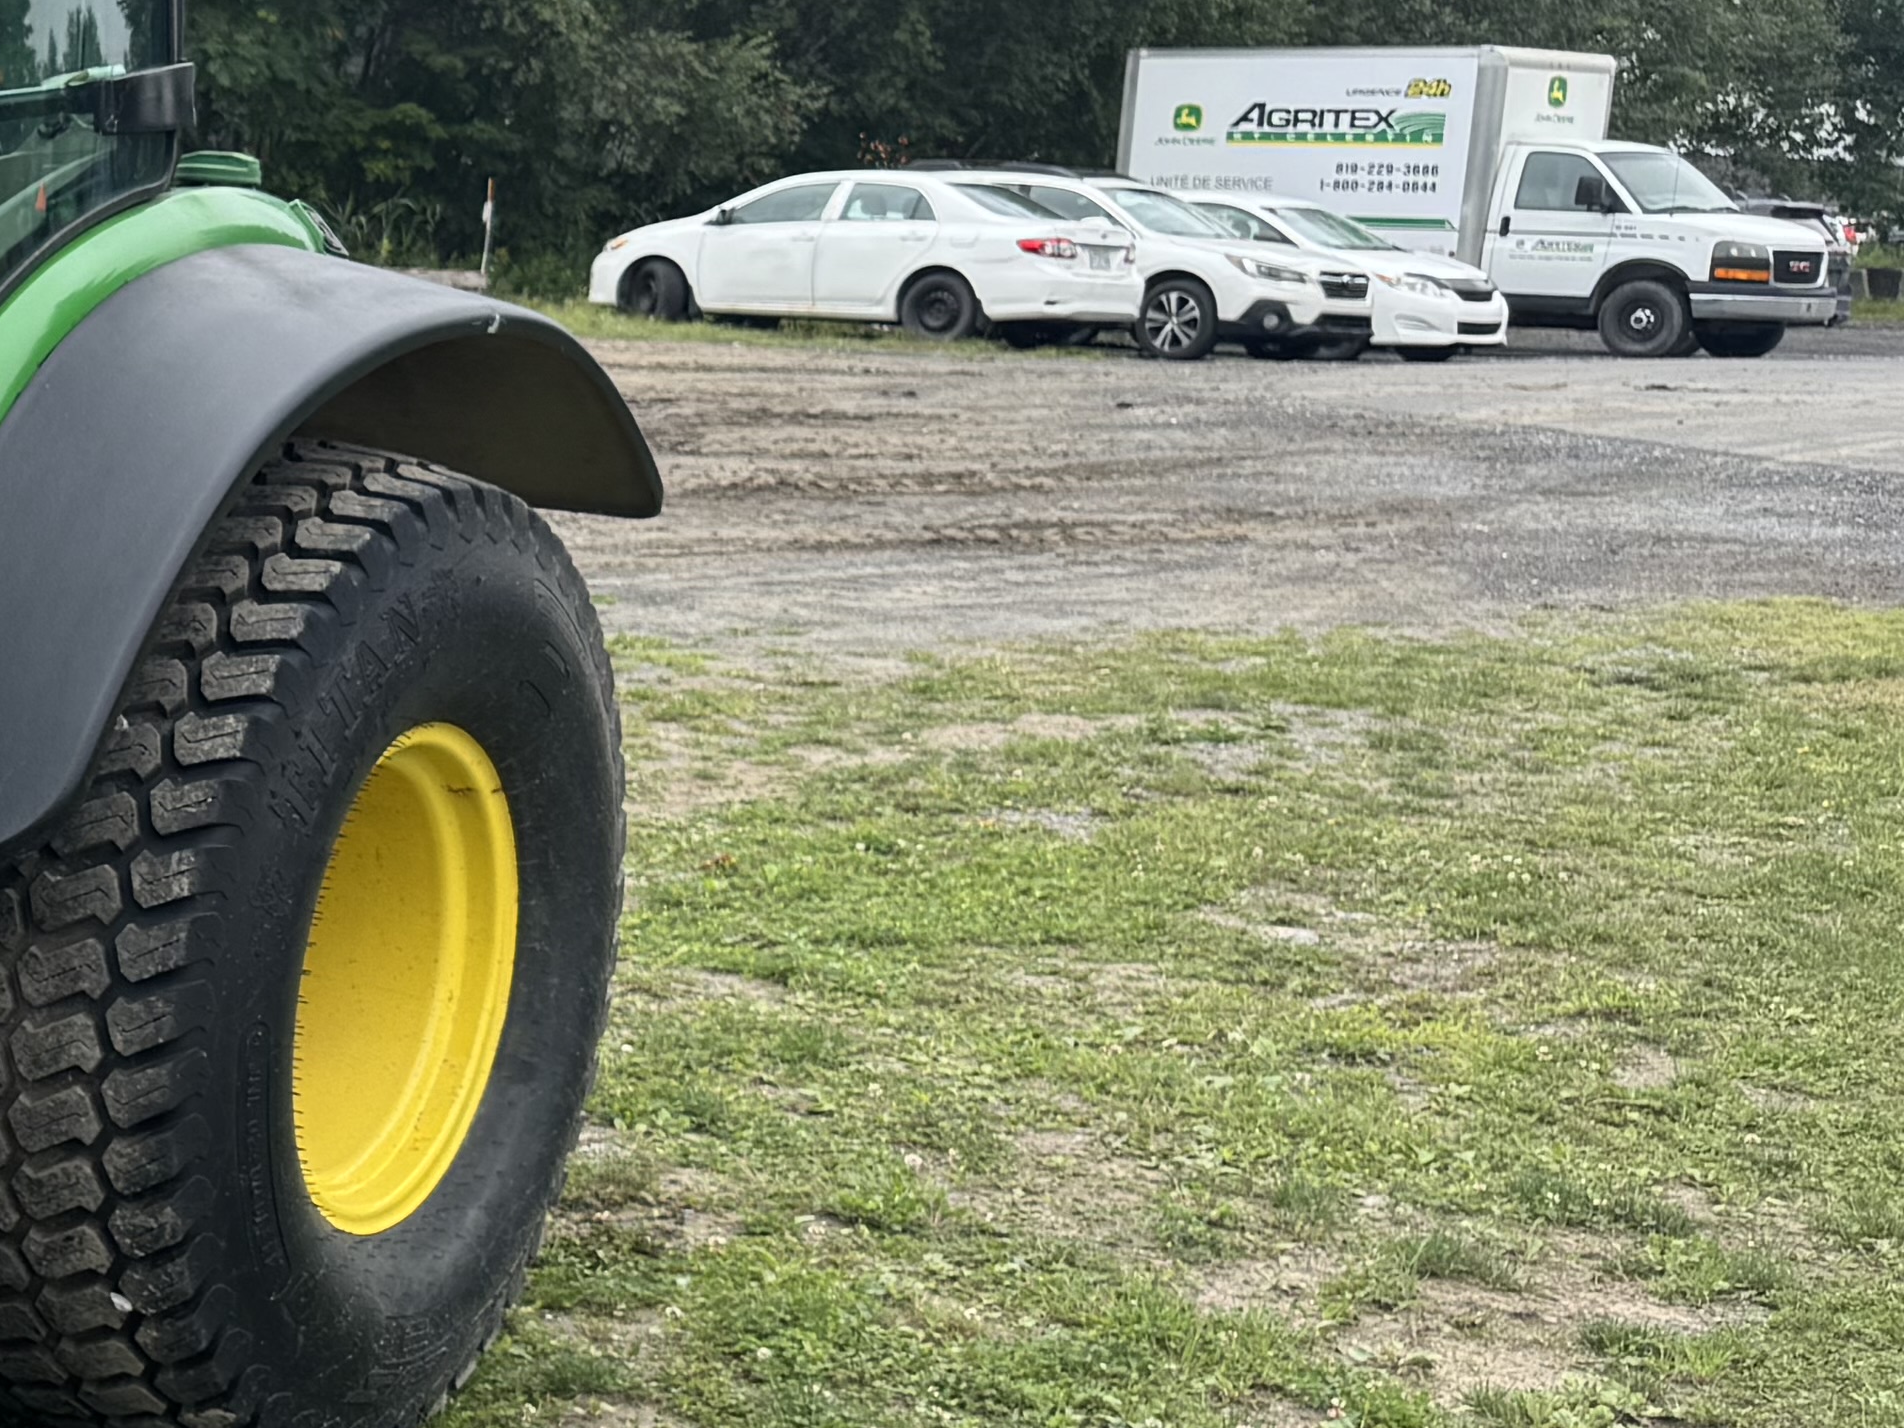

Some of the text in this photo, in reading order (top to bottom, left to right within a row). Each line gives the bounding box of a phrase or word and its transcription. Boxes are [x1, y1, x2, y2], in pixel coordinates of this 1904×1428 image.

[1404, 77, 1452, 99] 24h
[1229, 102, 1398, 130] AGRITEX
[1193, 174, 1211, 190] DE
[1214, 175, 1273, 191] SERVICE
